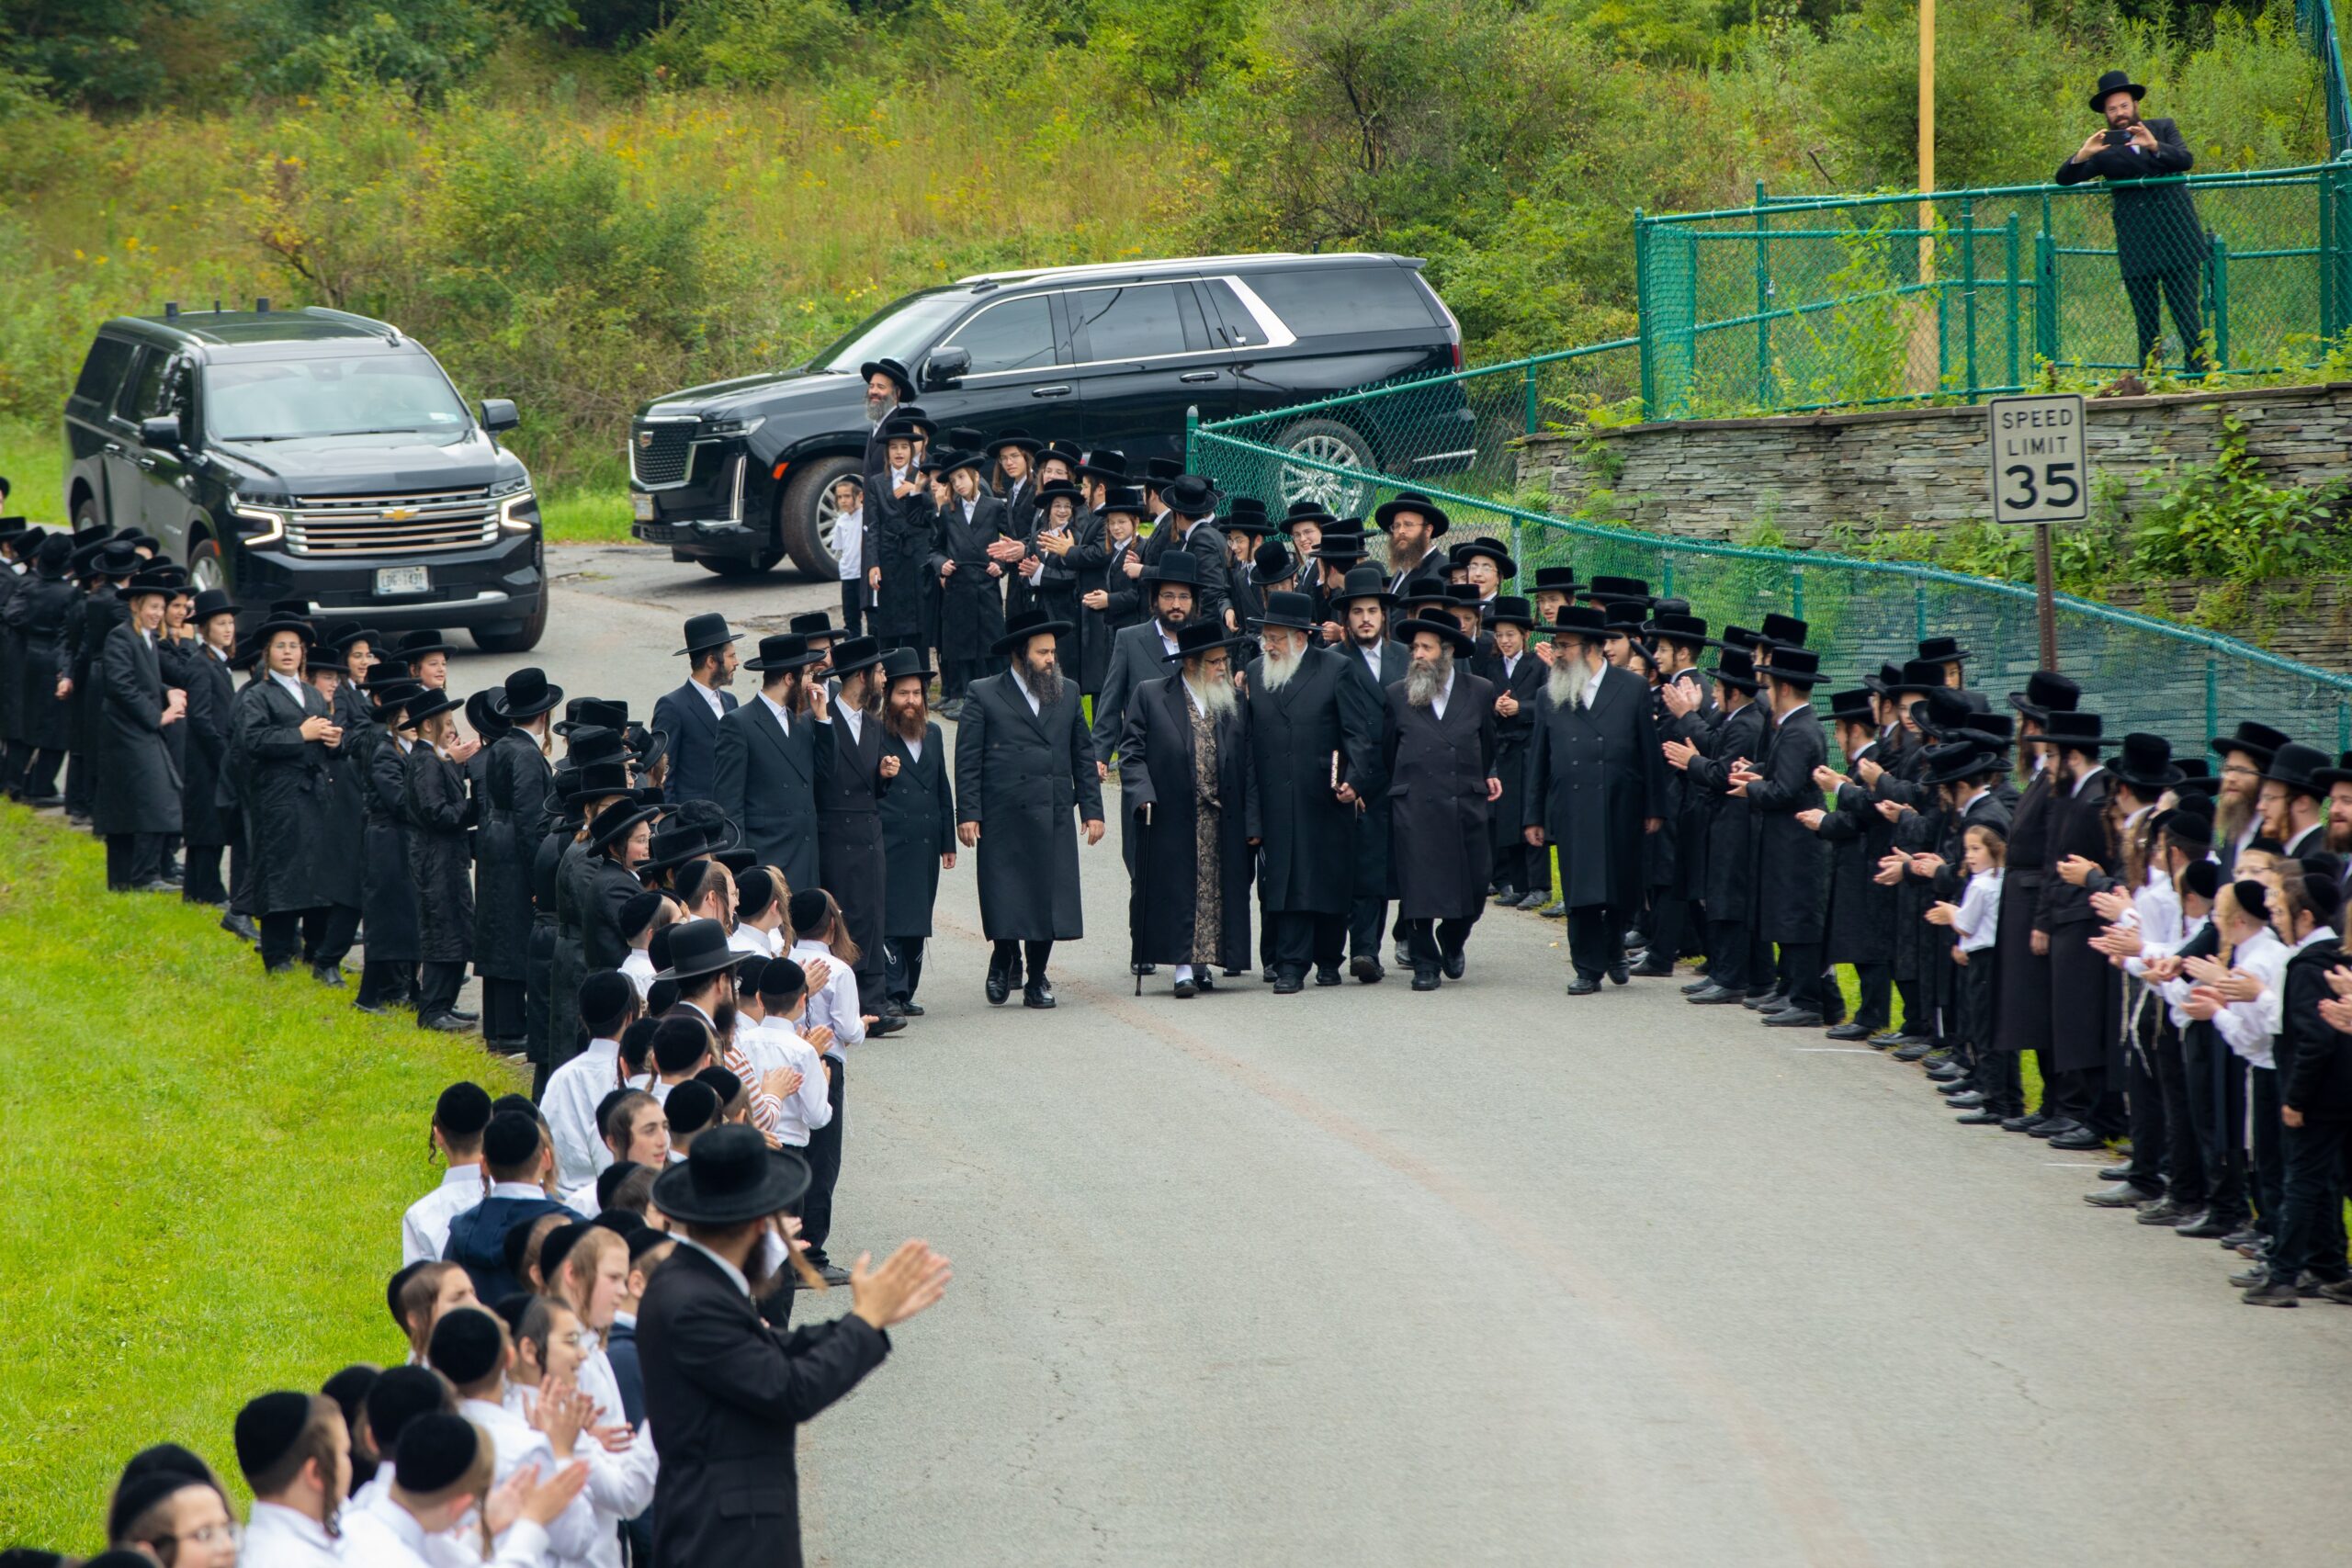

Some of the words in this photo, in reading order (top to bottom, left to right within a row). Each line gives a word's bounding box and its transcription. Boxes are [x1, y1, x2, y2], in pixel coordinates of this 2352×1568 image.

[2003, 409, 2073, 429] SPEED
[2007, 435, 2068, 456] LIMIT
[2004, 462, 2079, 510] 35
